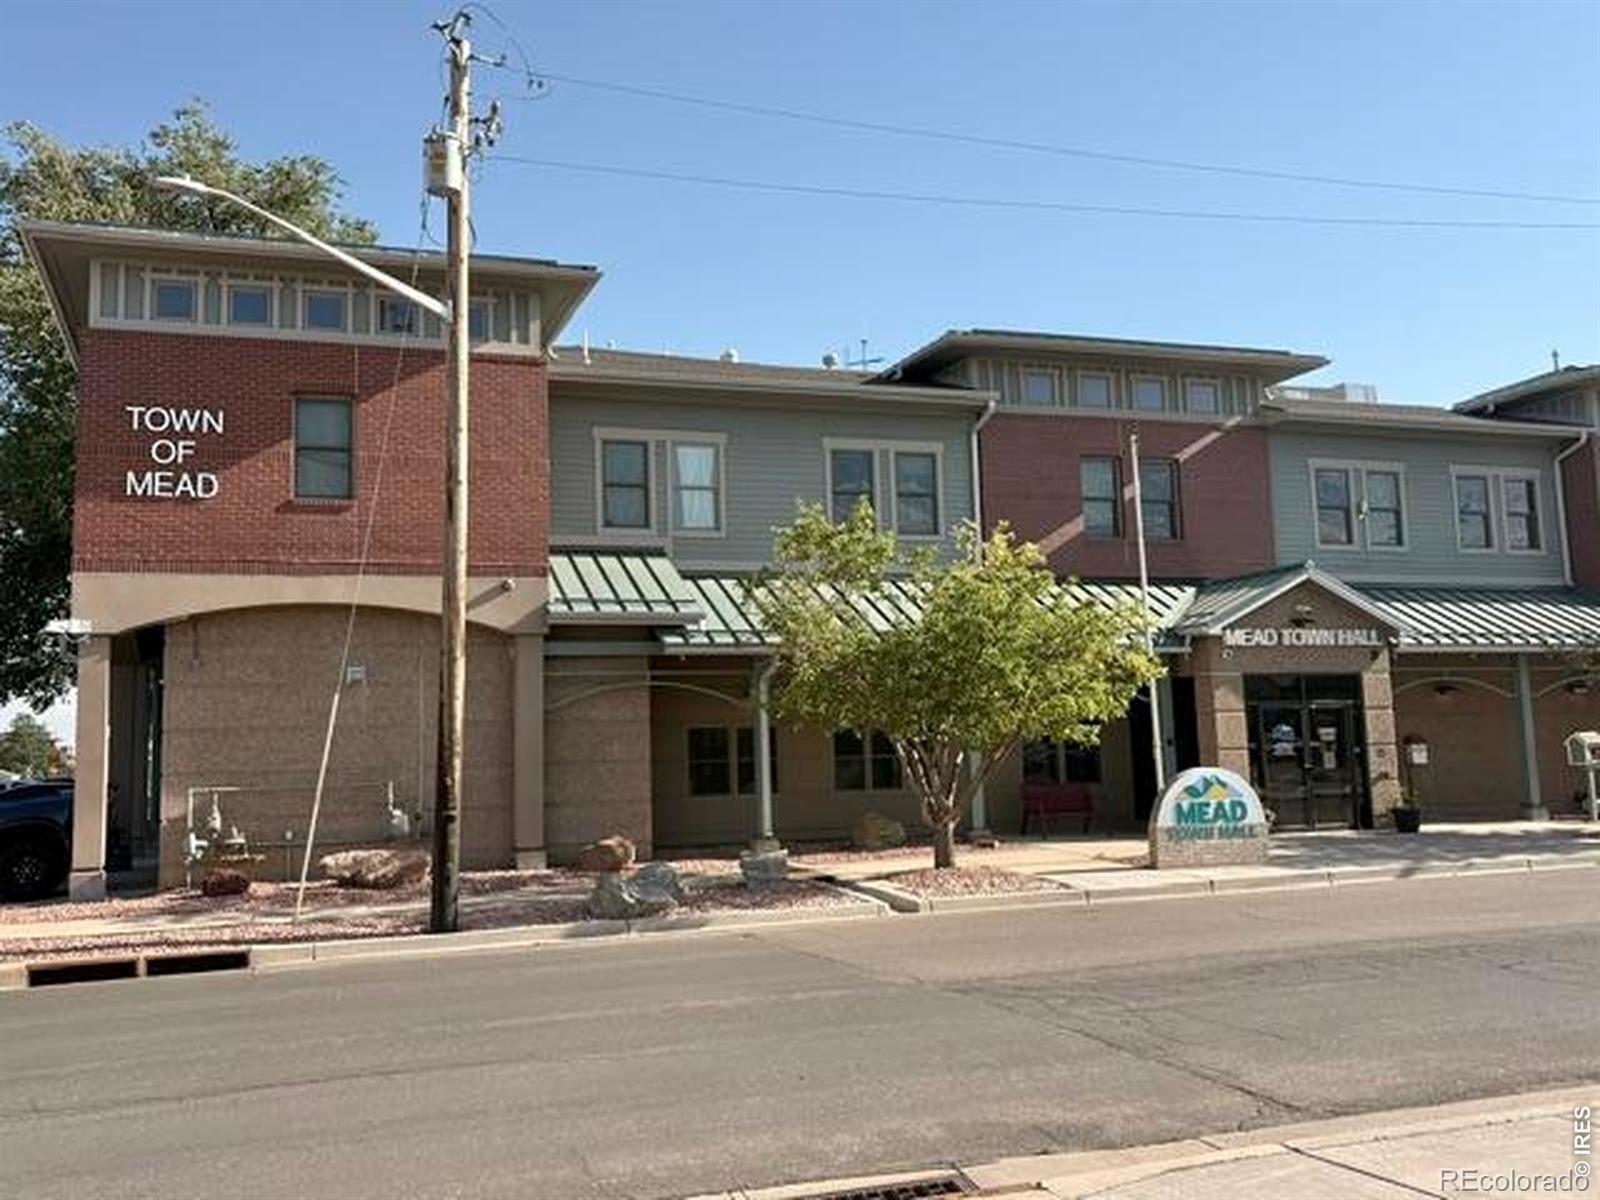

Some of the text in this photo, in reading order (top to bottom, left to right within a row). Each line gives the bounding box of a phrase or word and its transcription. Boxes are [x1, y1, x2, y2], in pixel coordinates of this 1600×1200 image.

[125, 406, 224, 433] TOWN
[151, 439, 195, 463] OF
[126, 471, 219, 498] MEAD
[1224, 628, 1382, 646] MEAD TOWN HALL
[1174, 800, 1248, 825] MEAD
